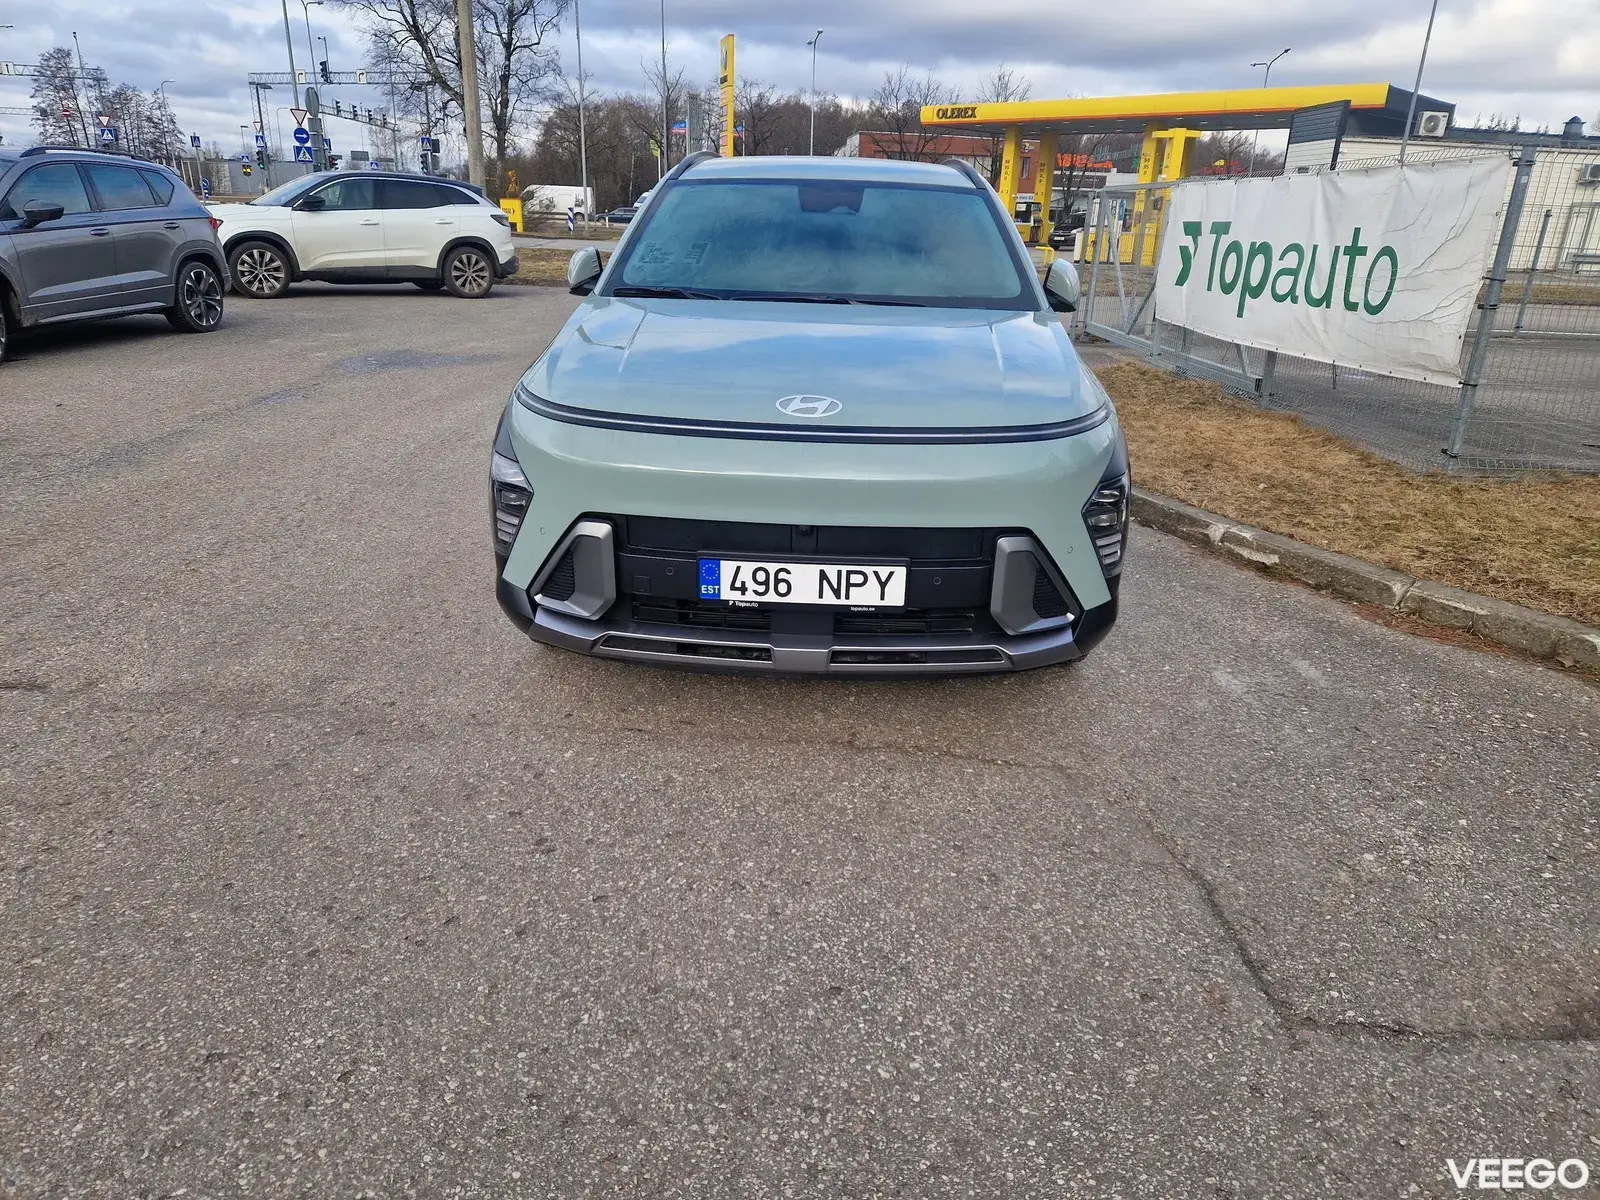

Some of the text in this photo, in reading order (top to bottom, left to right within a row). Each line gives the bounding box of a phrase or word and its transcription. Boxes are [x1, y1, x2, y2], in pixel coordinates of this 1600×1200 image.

[936, 106, 977, 119] OLEREX
[1207, 221, 1398, 318] Topauto
[701, 585, 719, 594] EST
[729, 565, 895, 601] 496 NPY
[734, 600, 759, 608] Topauto
